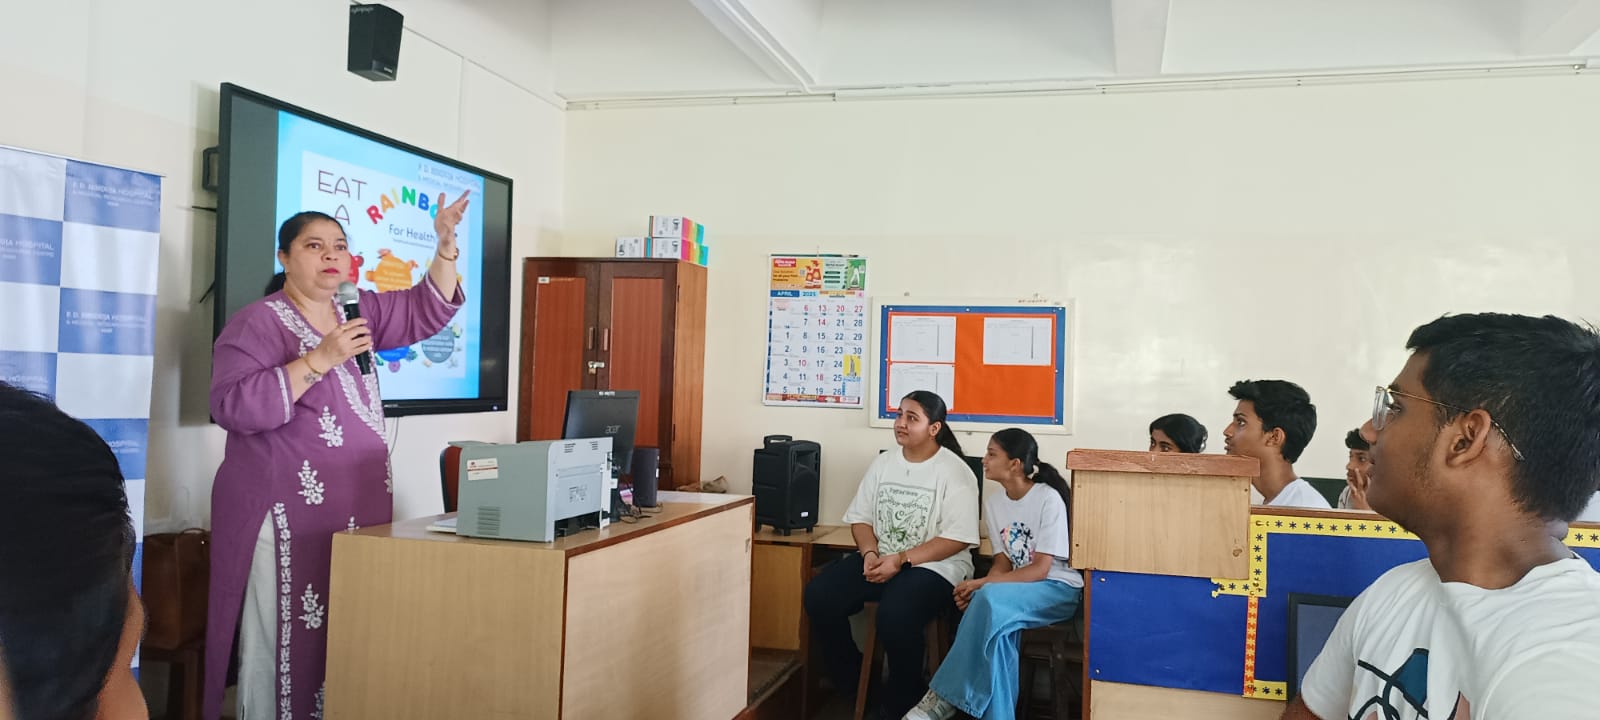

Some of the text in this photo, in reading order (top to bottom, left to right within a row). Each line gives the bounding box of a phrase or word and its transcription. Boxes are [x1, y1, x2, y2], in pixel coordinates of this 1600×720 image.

[318, 170, 367, 200] EAT
[334, 204, 351, 226] A
[366, 185, 439, 225] RAINBO
[389, 224, 436, 242] For Health
[605, 425, 622, 434] acer
